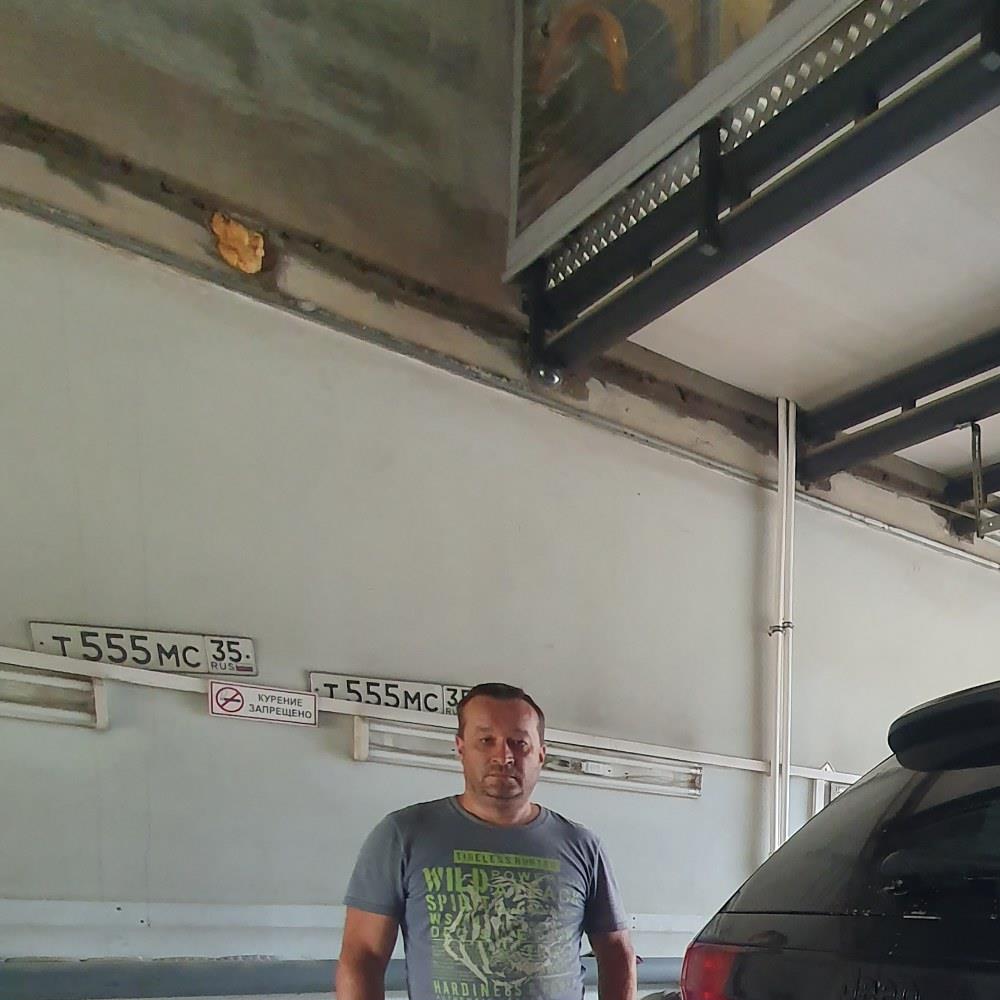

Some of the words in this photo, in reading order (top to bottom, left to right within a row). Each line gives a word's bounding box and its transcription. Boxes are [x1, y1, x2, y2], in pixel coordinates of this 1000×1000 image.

[210, 639, 243, 663] 35
[211, 661, 235, 671] RUS
[258, 693, 304, 708] КУРЕНИЕ
[249, 703, 313, 719] ЗАПРЕЩЕНО
[446, 707, 459, 715] RU
[423, 866, 489, 894] WILD
